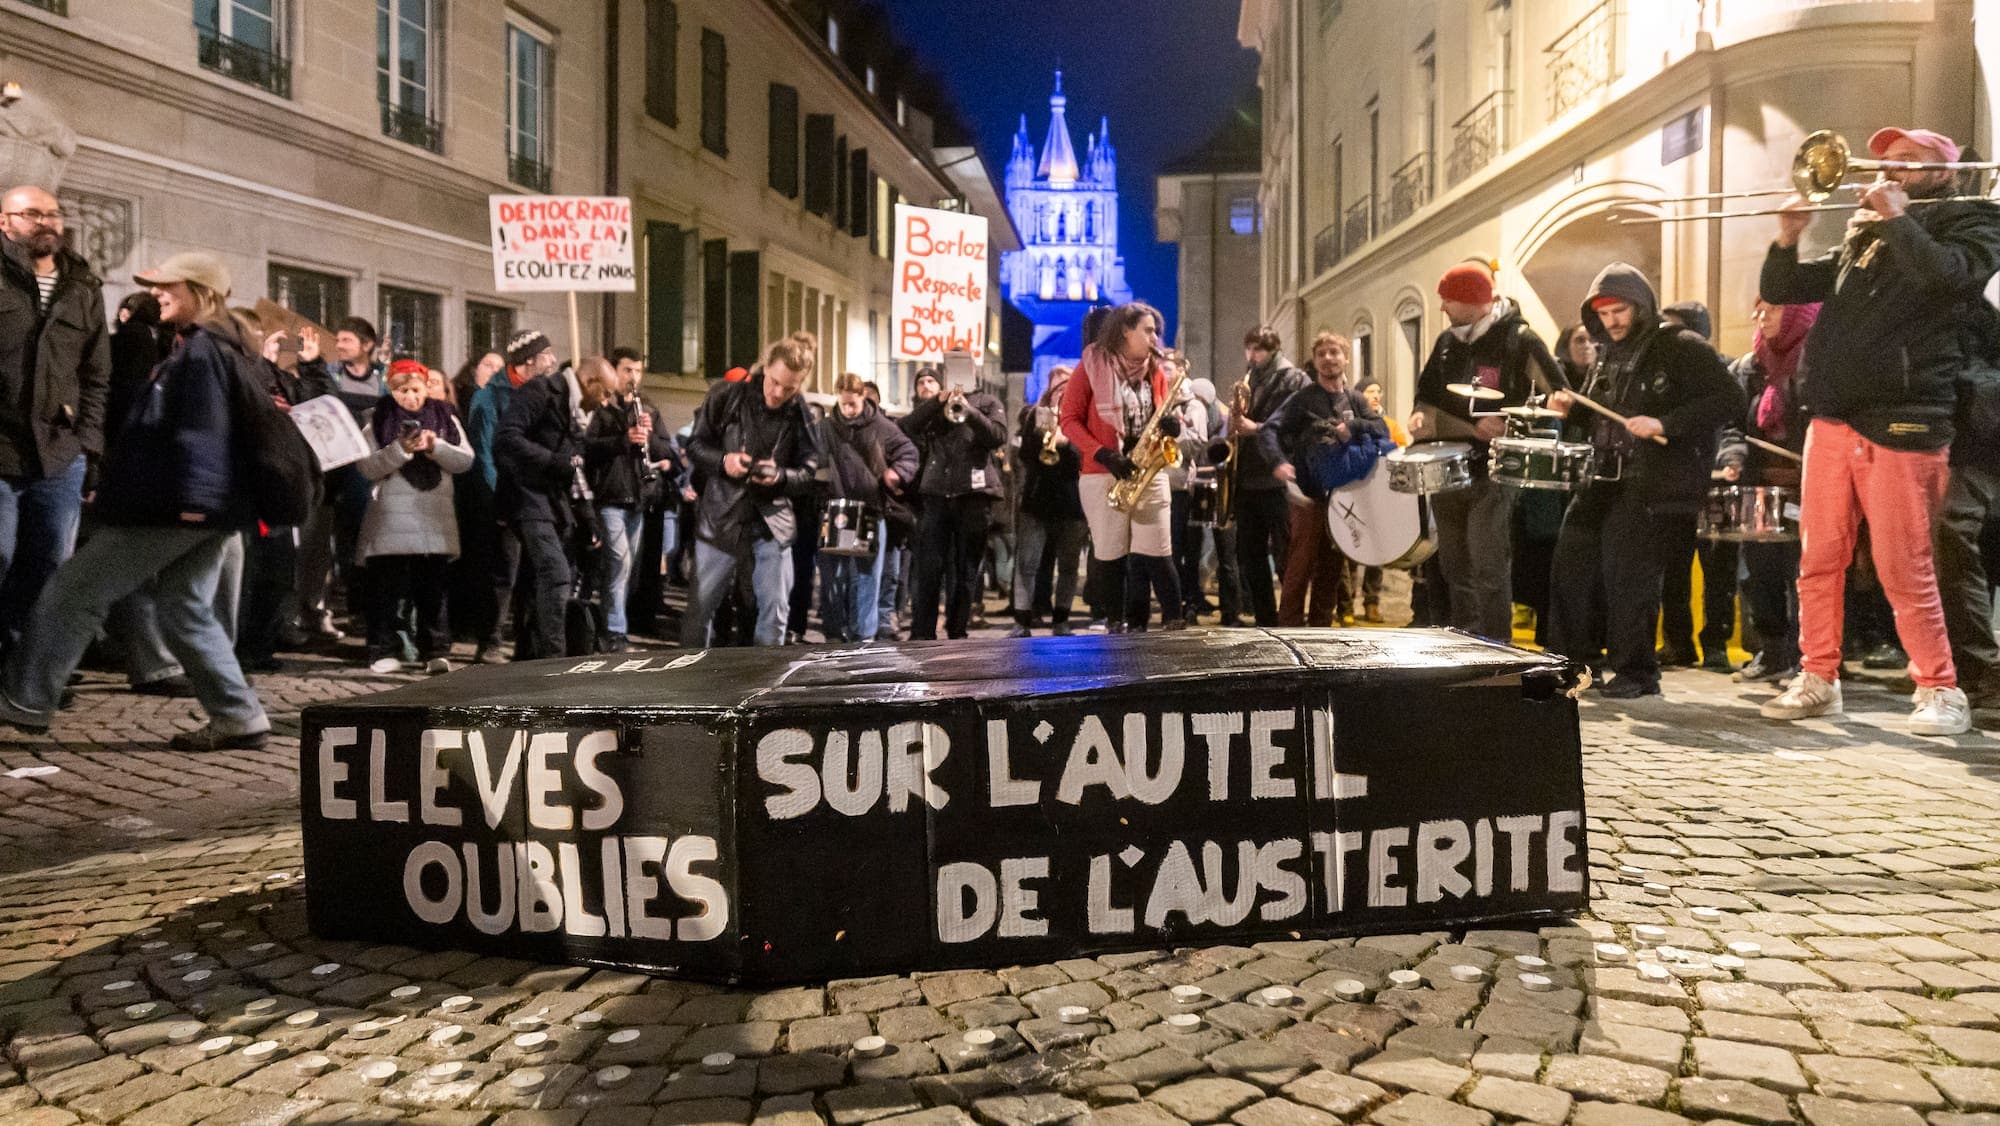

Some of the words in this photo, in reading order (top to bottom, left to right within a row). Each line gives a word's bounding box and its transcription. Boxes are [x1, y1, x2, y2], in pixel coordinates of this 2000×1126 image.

[522, 223, 580, 242] DANS
[590, 225, 617, 241] LA
[544, 243, 593, 262] RUE
[906, 216, 985, 260] Borloz
[504, 261, 591, 280] ECOUTEZ
[902, 260, 982, 302] Respecte
[911, 298, 954, 324] notre
[319, 726, 624, 831] ELEVES
[756, 720, 951, 820] SUR
[987, 707, 1368, 807] L'AUTEL
[403, 834, 729, 942] OUBLIES
[937, 856, 1050, 943] DE
[1087, 810, 1583, 935] L'AUSTERITE
